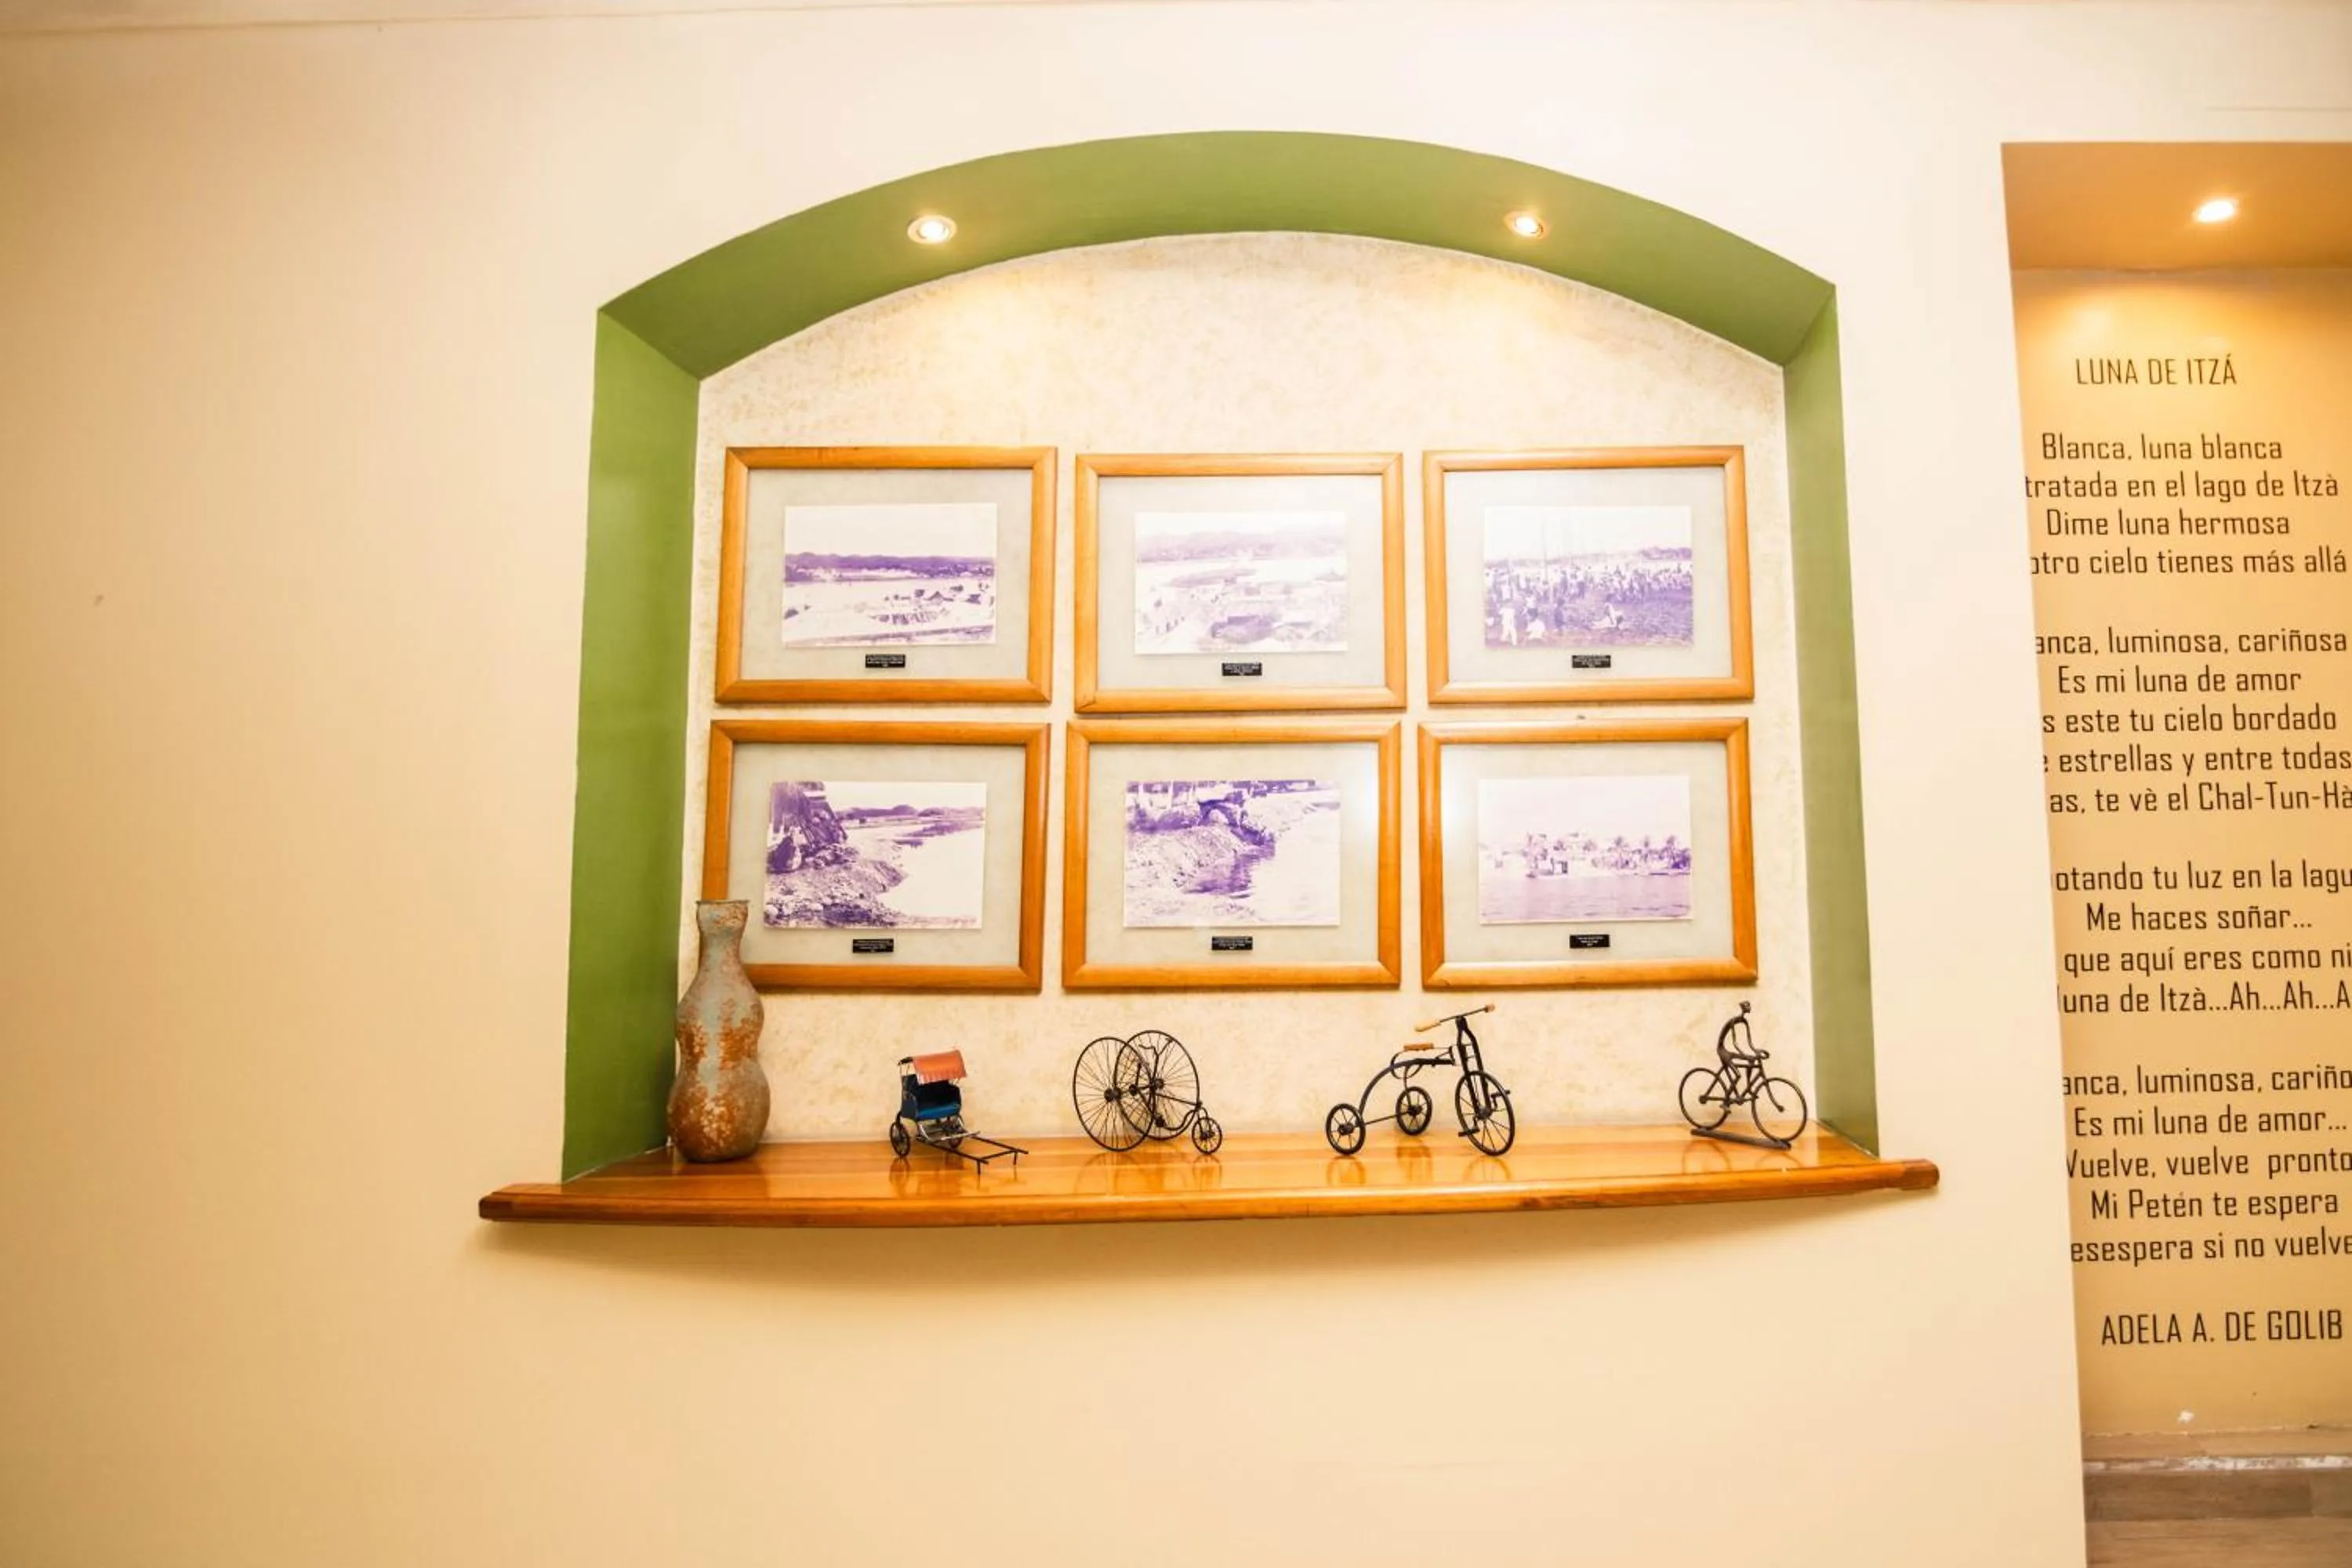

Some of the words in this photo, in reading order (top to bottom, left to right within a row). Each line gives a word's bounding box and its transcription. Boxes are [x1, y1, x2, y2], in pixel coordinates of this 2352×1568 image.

[2075, 358, 2139, 385] LUNA
[2147, 358, 2177, 385] DE
[2187, 353, 2238, 386] ITZÁ
[2042, 432, 2132, 461] Blanca,
[2140, 433, 2193, 460] luna
[2200, 432, 2282, 460] blanca
[2024, 470, 2118, 499] tratada
[2127, 479, 2156, 498] en
[2165, 470, 2186, 498] el
[2194, 470, 2247, 503] lago
[2256, 470, 2285, 498] de
[2292, 469, 2339, 497] Itzà
[2045, 507, 2109, 536] Dime
[2118, 507, 2170, 536] luna
[2178, 506, 2290, 535] hermosa
[2089, 546, 2148, 575] cielo
[2156, 549, 2234, 574] tienes
[2242, 549, 2296, 574] más
[2303, 544, 2347, 573] allá
[2107, 626, 2229, 655] luminosa,
[2238, 627, 2347, 653] cariñosa
[2057, 664, 2086, 695] Es
[2096, 667, 2126, 694] mi
[2134, 664, 2188, 693] luna
[2197, 663, 2227, 693] de
[2235, 673, 2302, 692] amor
[2065, 709, 2121, 734] este
[2129, 708, 2154, 732] tu
[2164, 702, 2223, 732] cielo
[2231, 702, 2337, 731] bordado
[2058, 742, 2173, 773] estrellas
[2181, 752, 2195, 778] y
[2204, 746, 2274, 771] entre
[2281, 741, 2352, 771] todas
[2094, 788, 2120, 813] te
[2167, 782, 2189, 811] el
[2054, 860, 2143, 891] otando
[2151, 866, 2178, 891] tu
[2187, 859, 2223, 890] luz
[2232, 869, 2262, 889] en
[2270, 858, 2293, 889] la
[2301, 858, 2352, 895] lagu
[2085, 902, 2122, 931] Me
[2130, 901, 2208, 931] haces
[2216, 905, 2313, 930] soñar...
[2063, 953, 2111, 979] que
[2120, 946, 2175, 978] aquí
[2183, 950, 2243, 971] eres
[2252, 949, 2321, 971] como
[2330, 942, 2352, 969] ni
[2119, 982, 2150, 1013] de
[2136, 1064, 2263, 1094] luminosa,
[2270, 1063, 2352, 1091] cariño
[2074, 1105, 2103, 1138] Es
[2113, 1109, 2144, 1137] mi
[2153, 1105, 2209, 1135] luna
[2218, 1103, 2249, 1134] de
[2257, 1111, 2347, 1133] amor...
[2165, 1145, 2249, 1177] vuelve
[2267, 1147, 2352, 1180] pronto
[2090, 1189, 2118, 1220] Mi
[2128, 1188, 2203, 1220] Petén
[2212, 1191, 2238, 1218] te
[2248, 1194, 2339, 1222] espera
[2070, 1240, 2194, 1268] esespera
[2203, 1231, 2225, 1259] si
[2234, 1237, 2265, 1259] no
[2101, 1312, 2183, 1346] ADELA
[2191, 1312, 2216, 1343] A.
[2224, 1310, 2257, 1342] DE
[2267, 1308, 2343, 1341] GOLIB
